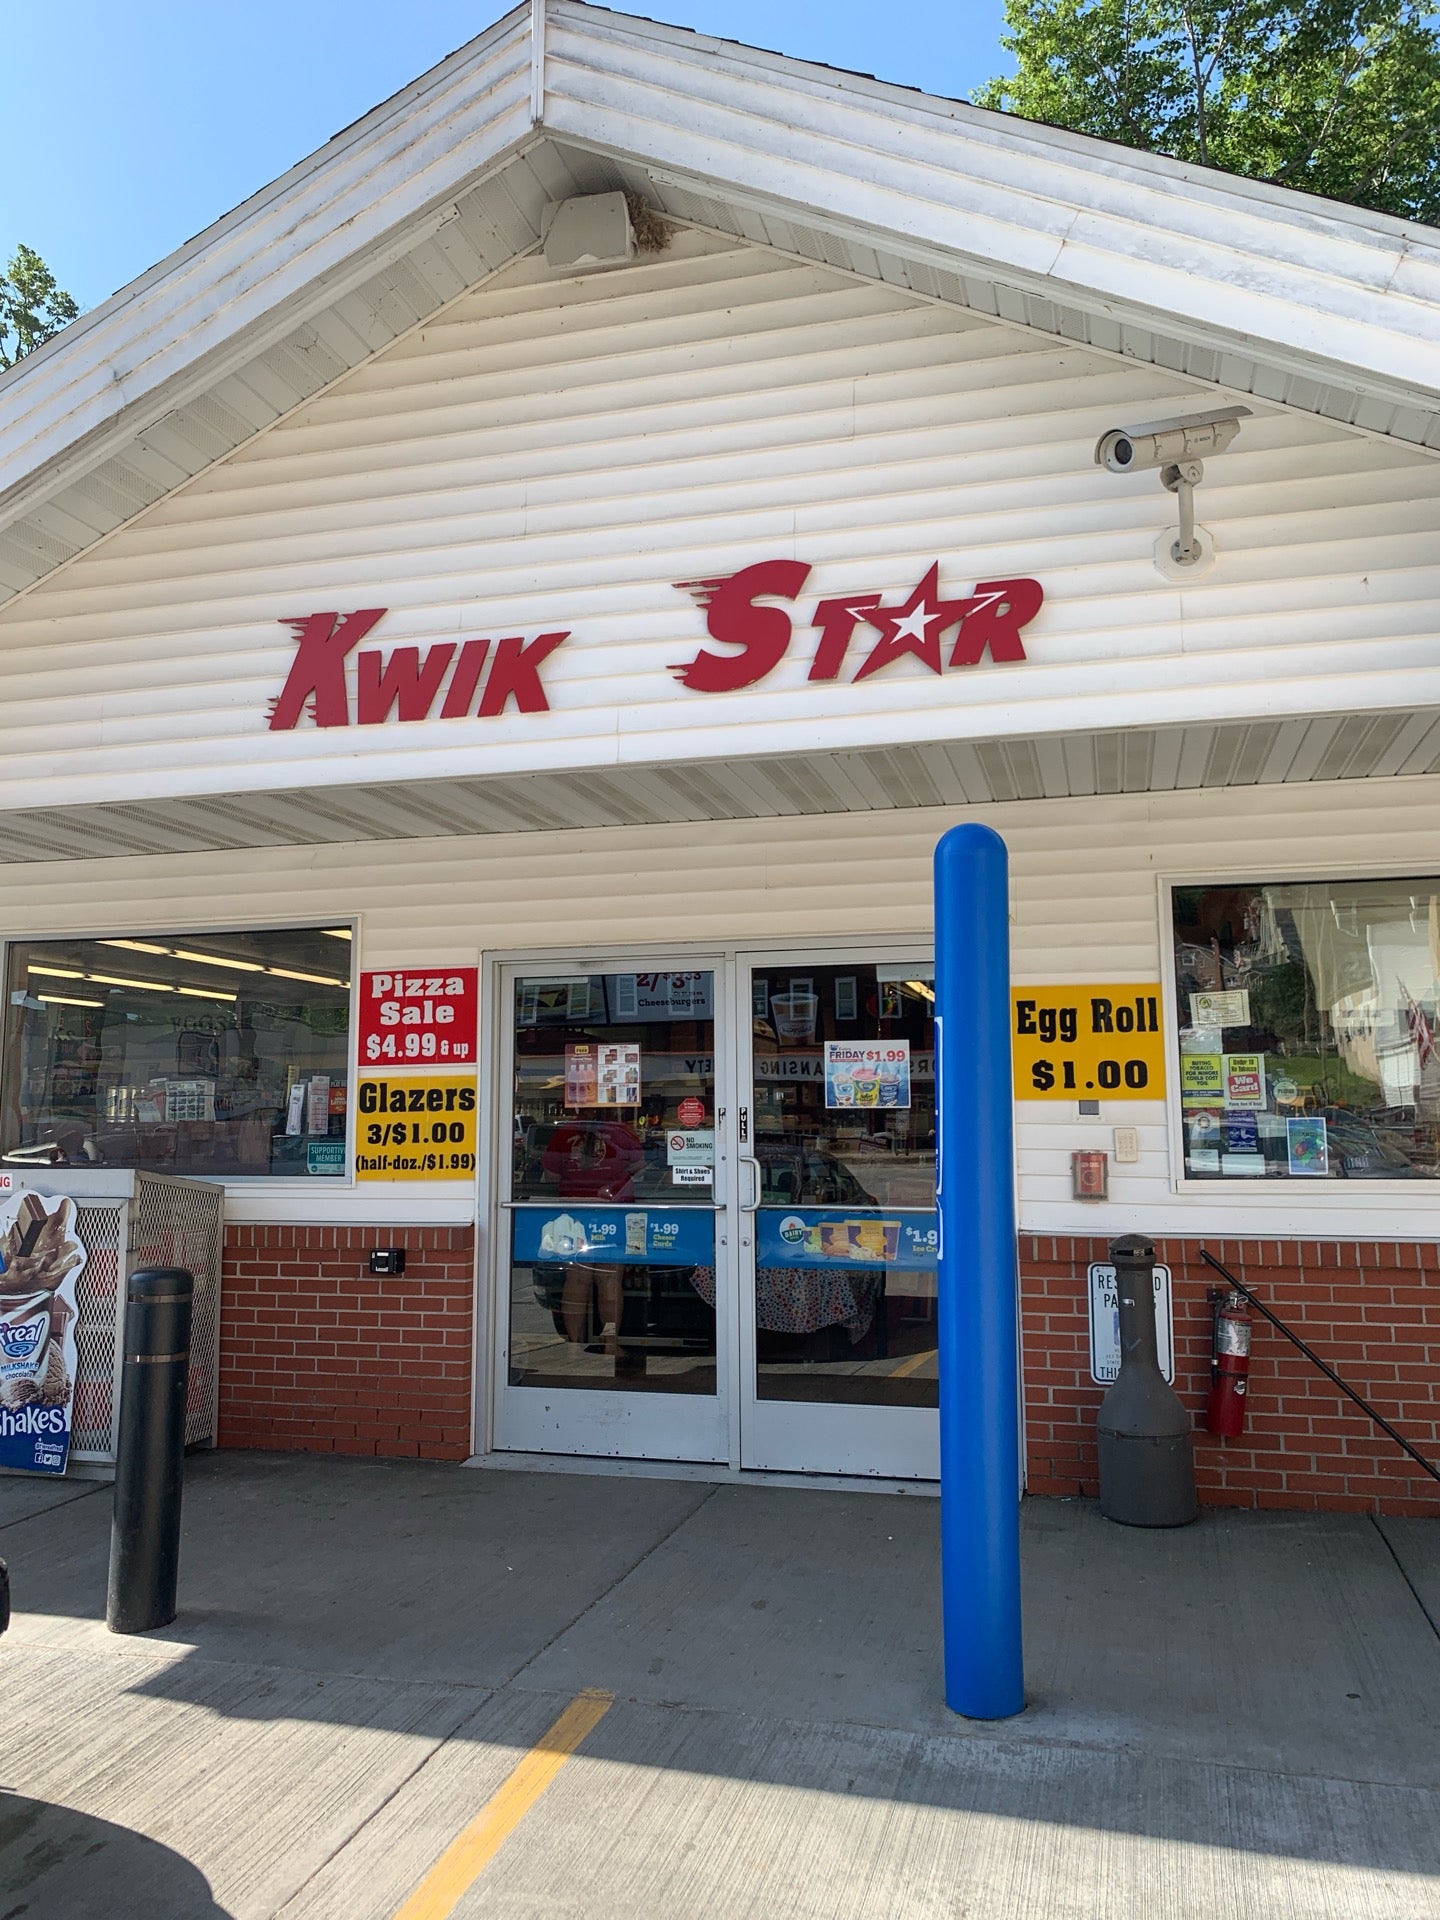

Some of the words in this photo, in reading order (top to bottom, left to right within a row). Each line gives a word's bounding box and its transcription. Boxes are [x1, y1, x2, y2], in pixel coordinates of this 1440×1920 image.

[371, 974, 465, 998] Pizza
[638, 998, 706, 1007] Cheeseburgers
[380, 1000, 455, 1026] Sale
[1016, 1000, 1077, 1043] Egg
[1090, 997, 1159, 1033] Roll
[366, 1033, 437, 1060] $4.99
[440, 1040, 449, 1056] &
[453, 1042, 469, 1058] up
[829, 1051, 866, 1059] FRIDAY
[866, 1049, 906, 1063] $1.99
[1031, 1060, 1148, 1091] $1.00
[1234, 1076, 1254, 1084] We
[1230, 1082, 1258, 1093] Card
[359, 1081, 476, 1114] Glazers
[367, 1122, 465, 1147] 3/$1.00
[311, 1146, 346, 1154] SUPPORTIV
[316, 1154, 342, 1162] MEMBER
[356, 1153, 476, 1172] (half-doz./$1.99)
[588, 1223, 617, 1235] $1.99
[650, 1223, 679, 1235] $1.99
[905, 1226, 938, 1245] $1.9
[1, 1362, 39, 1372] MILKSHAKE
[5, 1370, 33, 1380] chocolate
[0, 1406, 63, 1436] hakes
